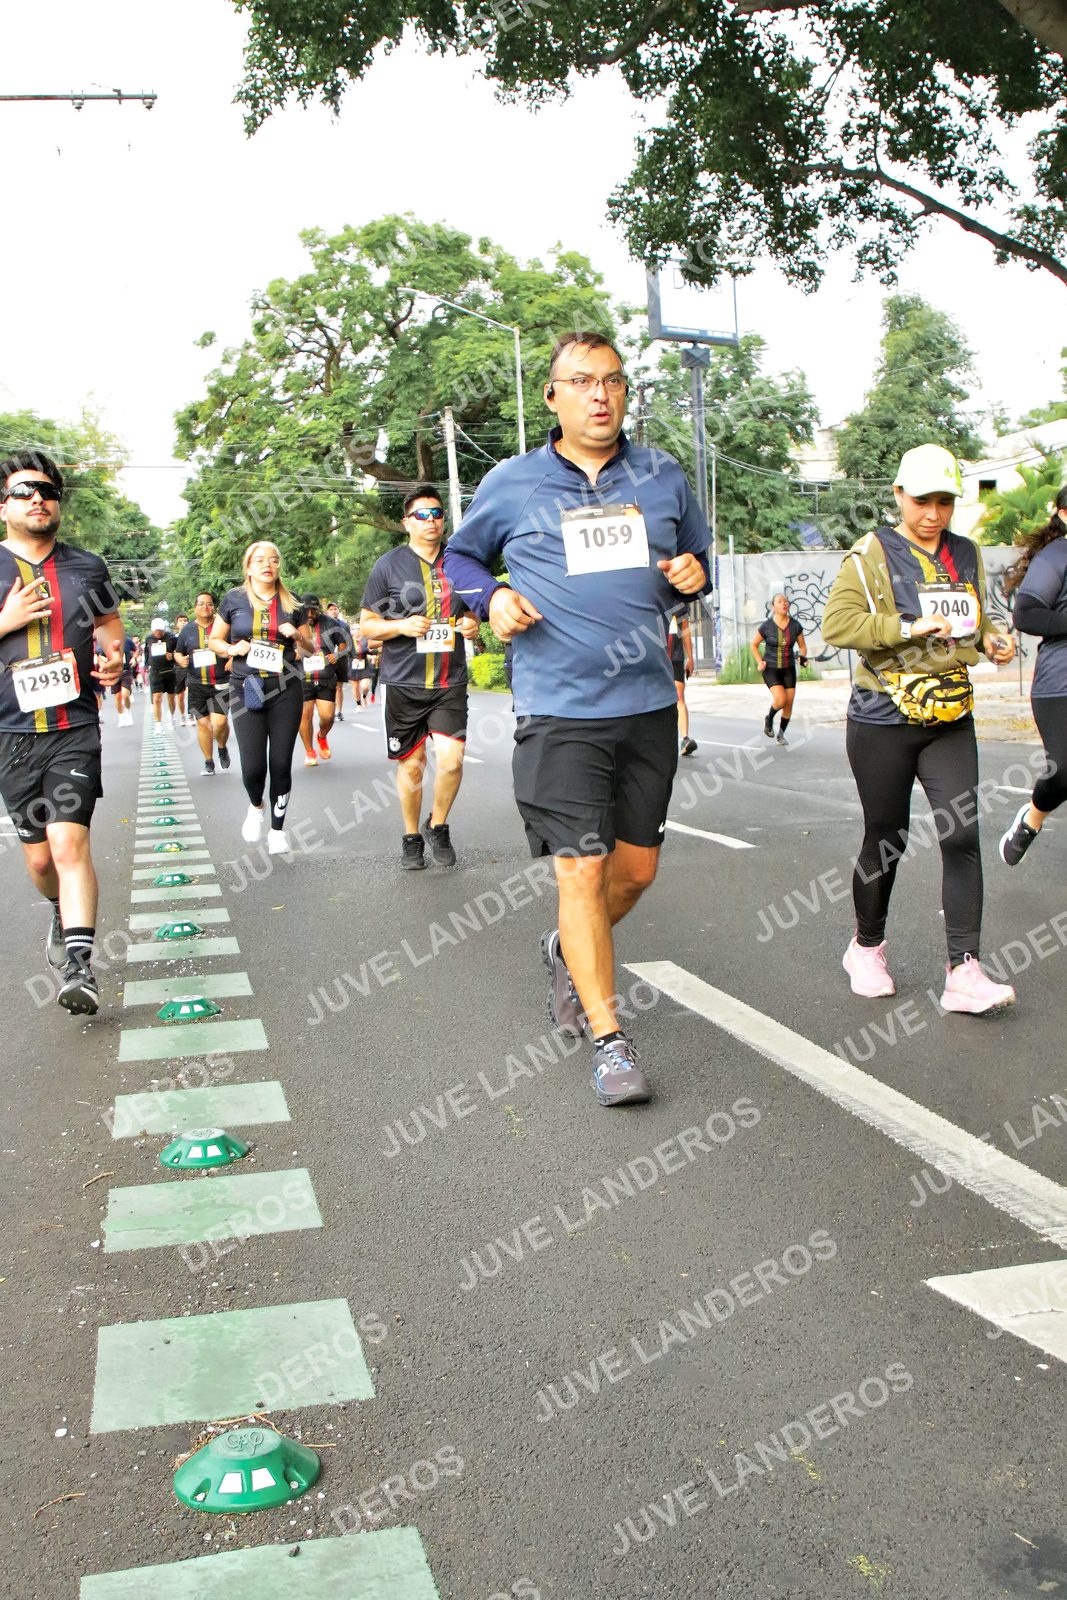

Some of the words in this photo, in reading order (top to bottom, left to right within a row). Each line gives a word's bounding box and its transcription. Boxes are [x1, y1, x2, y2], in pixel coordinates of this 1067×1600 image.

[579, 523, 633, 549] 1059
[785, 570, 826, 586] TOY
[930, 599, 970, 617] 2040
[253, 648, 276, 661] 6575
[17, 667, 72, 694] 12938
